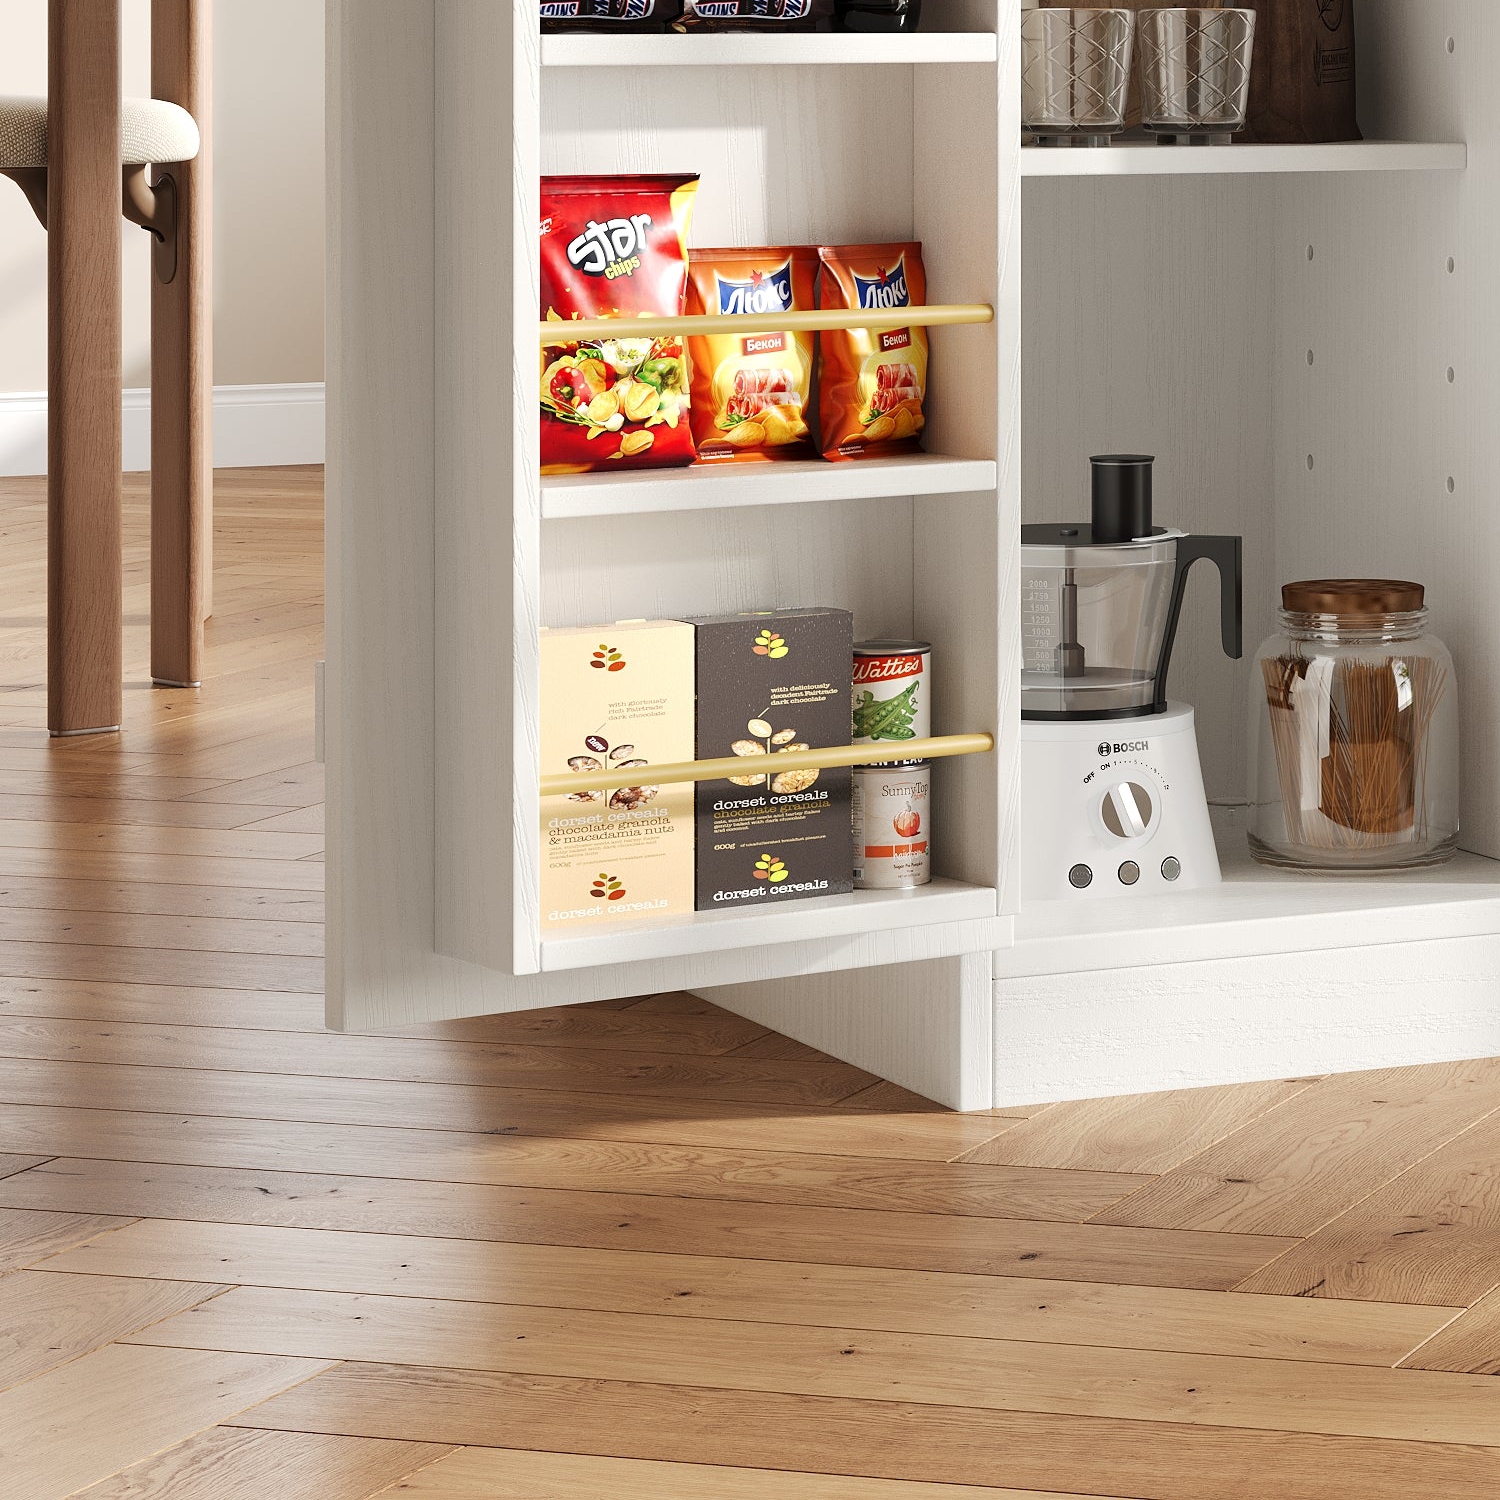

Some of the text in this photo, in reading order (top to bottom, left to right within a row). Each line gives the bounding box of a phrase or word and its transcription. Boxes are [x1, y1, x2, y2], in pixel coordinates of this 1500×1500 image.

[605, 256, 641, 280] chips
[721, 280, 790, 314] Люкс
[861, 276, 908, 309] Люкс
[746, 337, 782, 352] Бекон
[883, 333, 908, 347] Бекон
[1029, 580, 1048, 588] 2000
[1032, 616, 1050, 624] 1250
[1032, 628, 1051, 636] 1000
[853, 657, 919, 680] Wattie's
[771, 688, 838, 700] decadent Fairtrade
[790, 683, 830, 692] deliciously
[628, 698, 668, 707] gloriously
[790, 696, 826, 704] chocolate
[627, 705, 663, 713] Fairtrade
[628, 711, 666, 719] chocolate
[587, 736, 606, 752] new
[1113, 741, 1149, 753] BOSCH
[1083, 771, 1095, 784] OFF
[1100, 762, 1111, 771] ON
[881, 782, 929, 798] SunnyTop
[713, 790, 828, 811] dorset cereals
[548, 807, 668, 828] dorset cereals
[713, 800, 831, 819] chocolate granola
[549, 817, 671, 836] chocolate granola
[549, 836, 561, 845] &
[564, 829, 641, 844] macadamia
[645, 825, 674, 835] nuts
[549, 861, 571, 869] 600g
[713, 879, 828, 902] dorset cereals
[548, 899, 668, 921] dorset cereals
